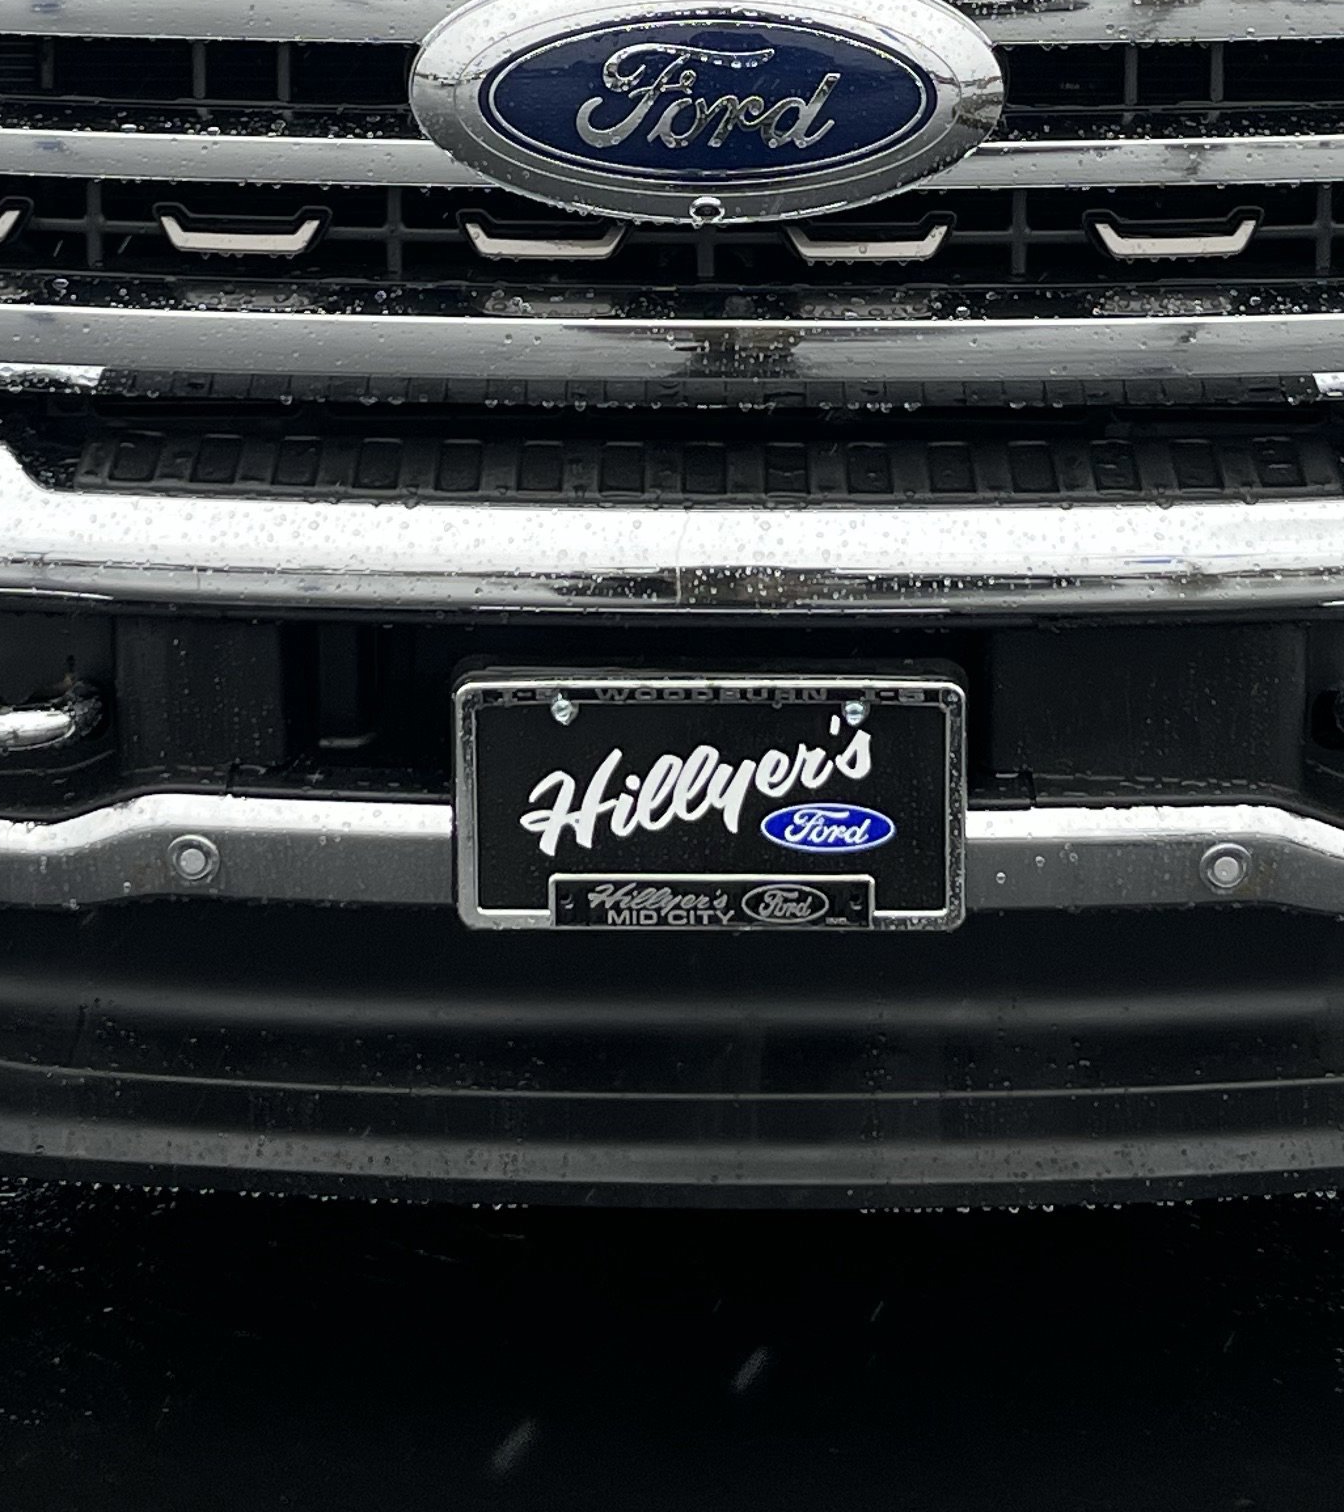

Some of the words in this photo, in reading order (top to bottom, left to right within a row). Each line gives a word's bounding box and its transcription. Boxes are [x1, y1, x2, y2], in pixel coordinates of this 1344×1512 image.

[576, 41, 839, 149] Ford
[594, 688, 829, 702] WOODBURN
[520, 714, 873, 857] Hillyer's
[783, 809, 871, 846] Ford
[587, 883, 728, 916] Hillyer's
[758, 890, 813, 918] Ford
[607, 910, 662, 925] MID
[667, 910, 735, 925] CITY
